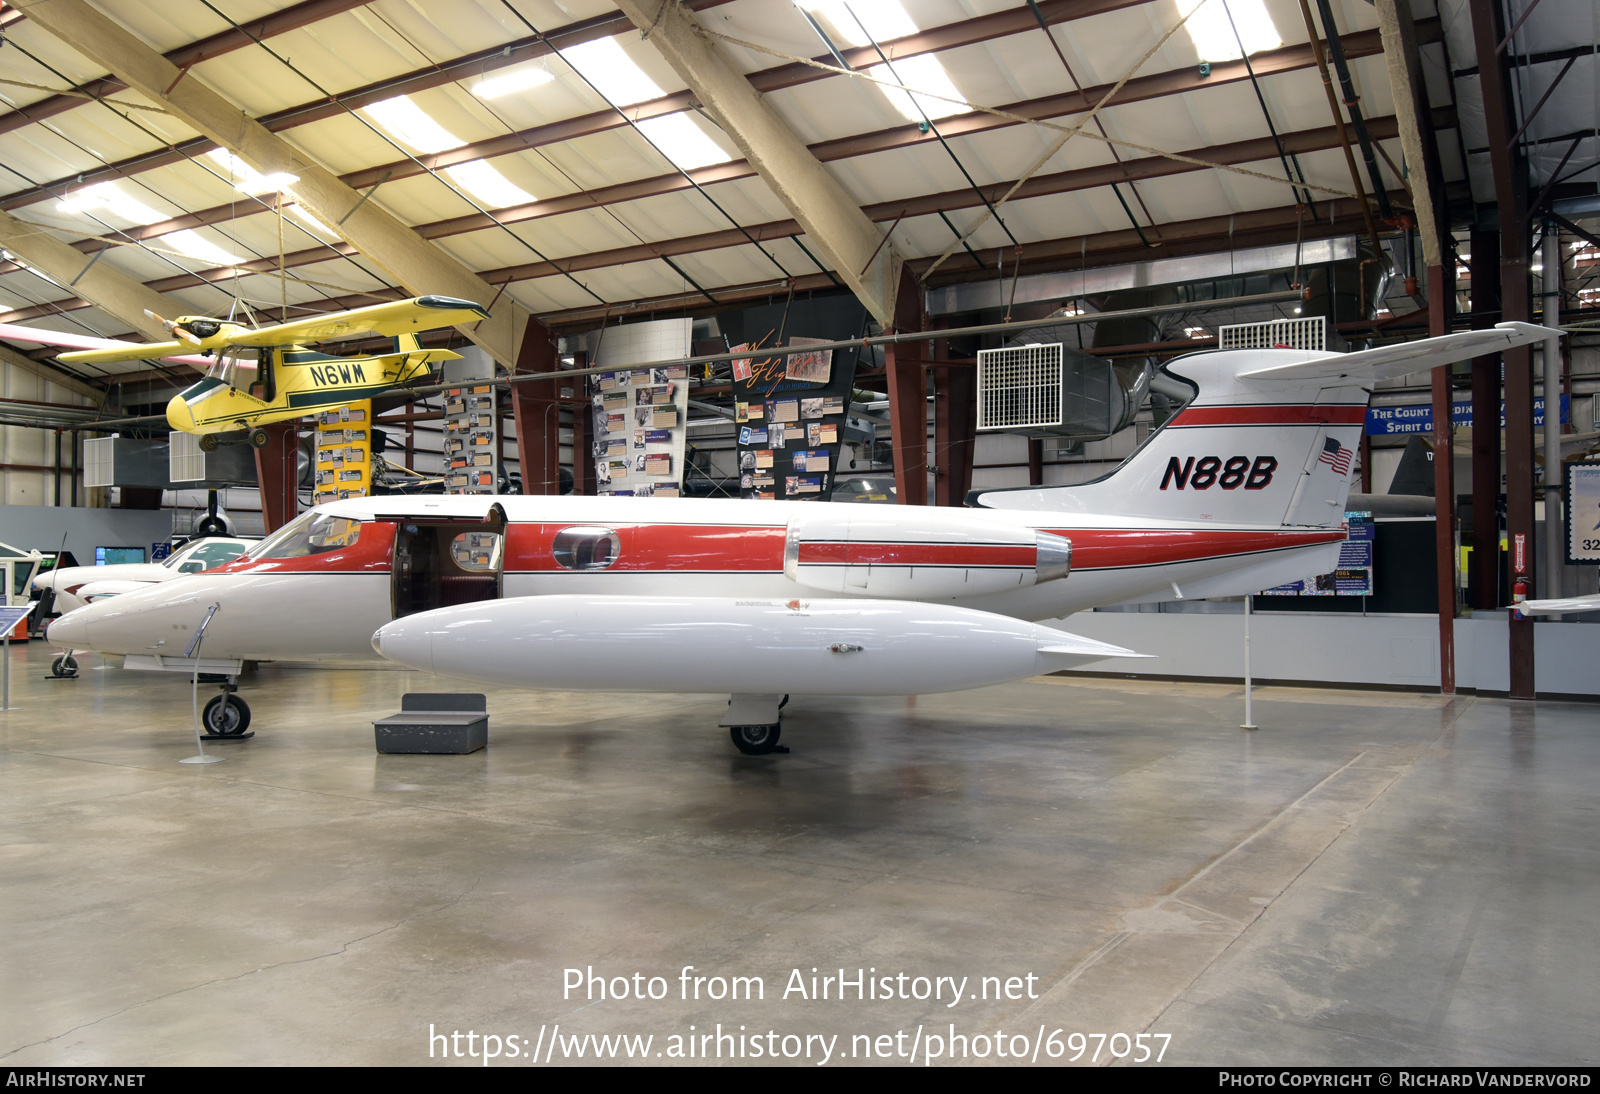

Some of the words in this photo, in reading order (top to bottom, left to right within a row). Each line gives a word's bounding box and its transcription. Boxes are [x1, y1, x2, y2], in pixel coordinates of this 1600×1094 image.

[310, 363, 366, 387] N6WM
[236, 390, 267, 408] EXPERIMENTAL
[1159, 456, 1278, 490] N88B
